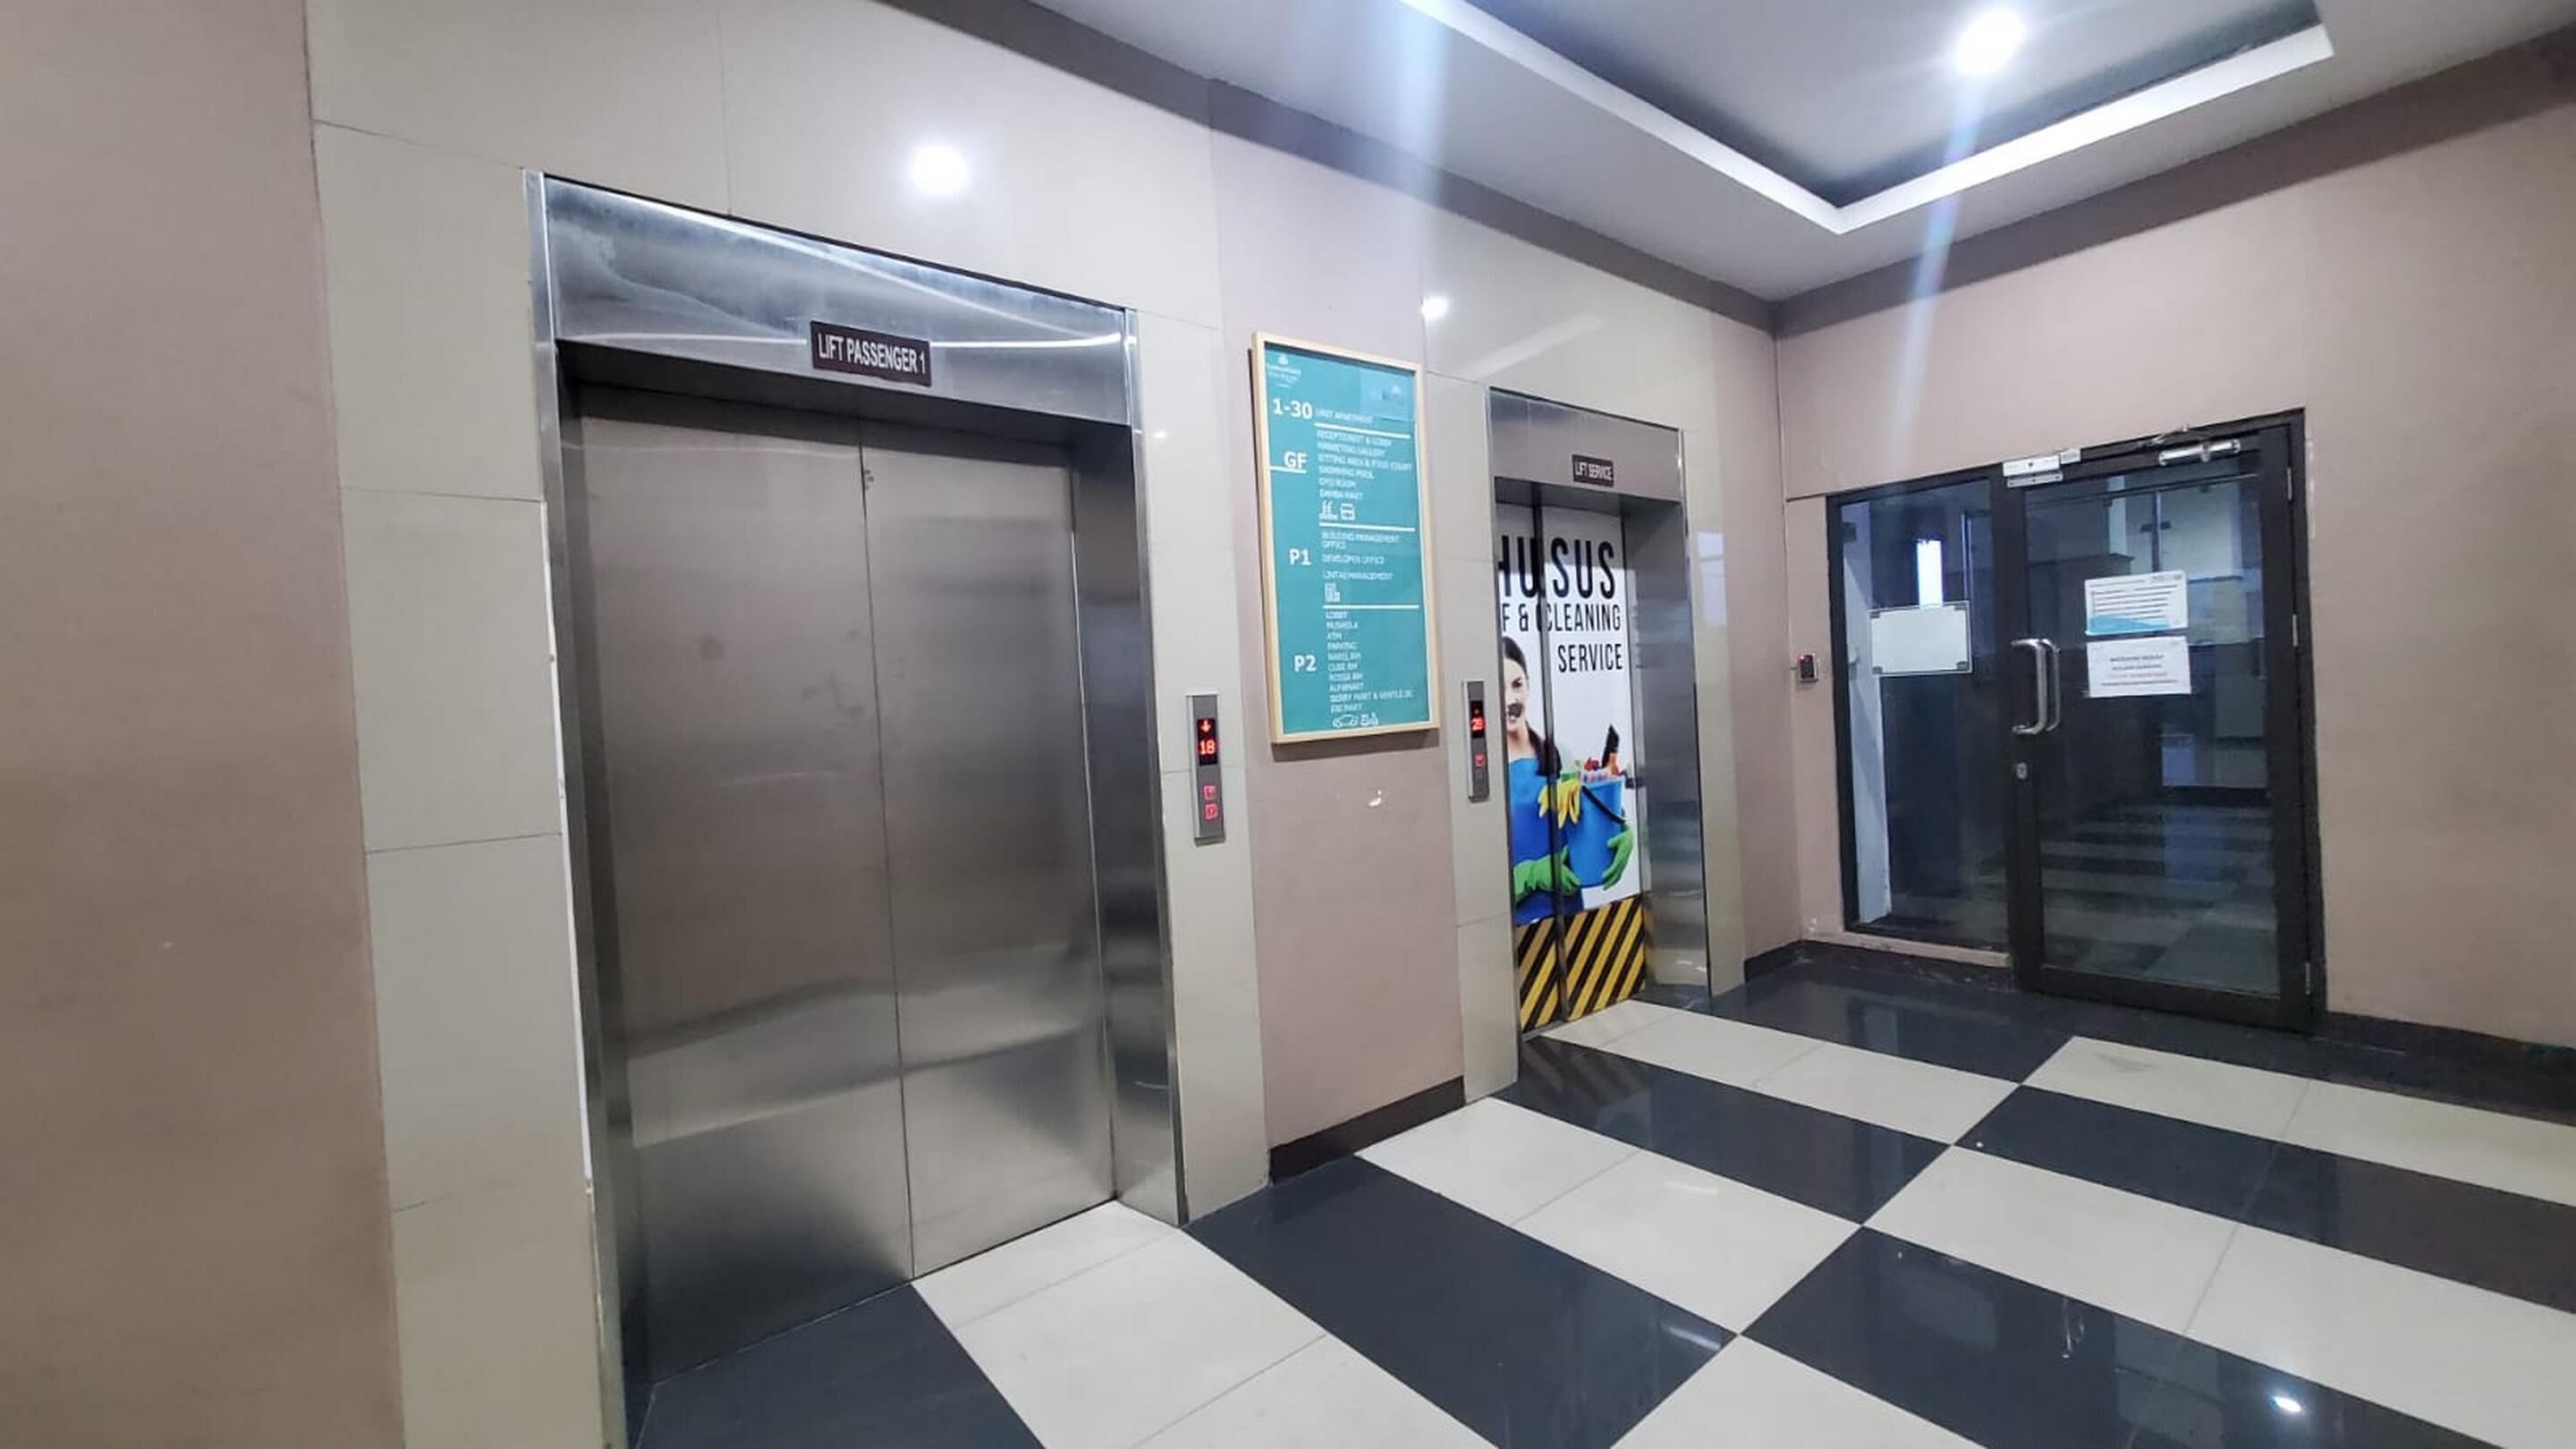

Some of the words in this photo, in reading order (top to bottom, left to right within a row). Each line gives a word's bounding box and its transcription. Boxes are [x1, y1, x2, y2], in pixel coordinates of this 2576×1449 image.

[818, 333, 843, 360] LIFT
[846, 337, 918, 374] PASSENGER
[919, 350, 926, 374] 1
[1273, 397, 1313, 419] 1-30
[1284, 451, 1307, 469] GF
[1288, 547, 1312, 567] P1
[1293, 654, 1317, 674] P2
[1557, 643, 1623, 673] SERVICE
[1199, 740, 1216, 755] 18
